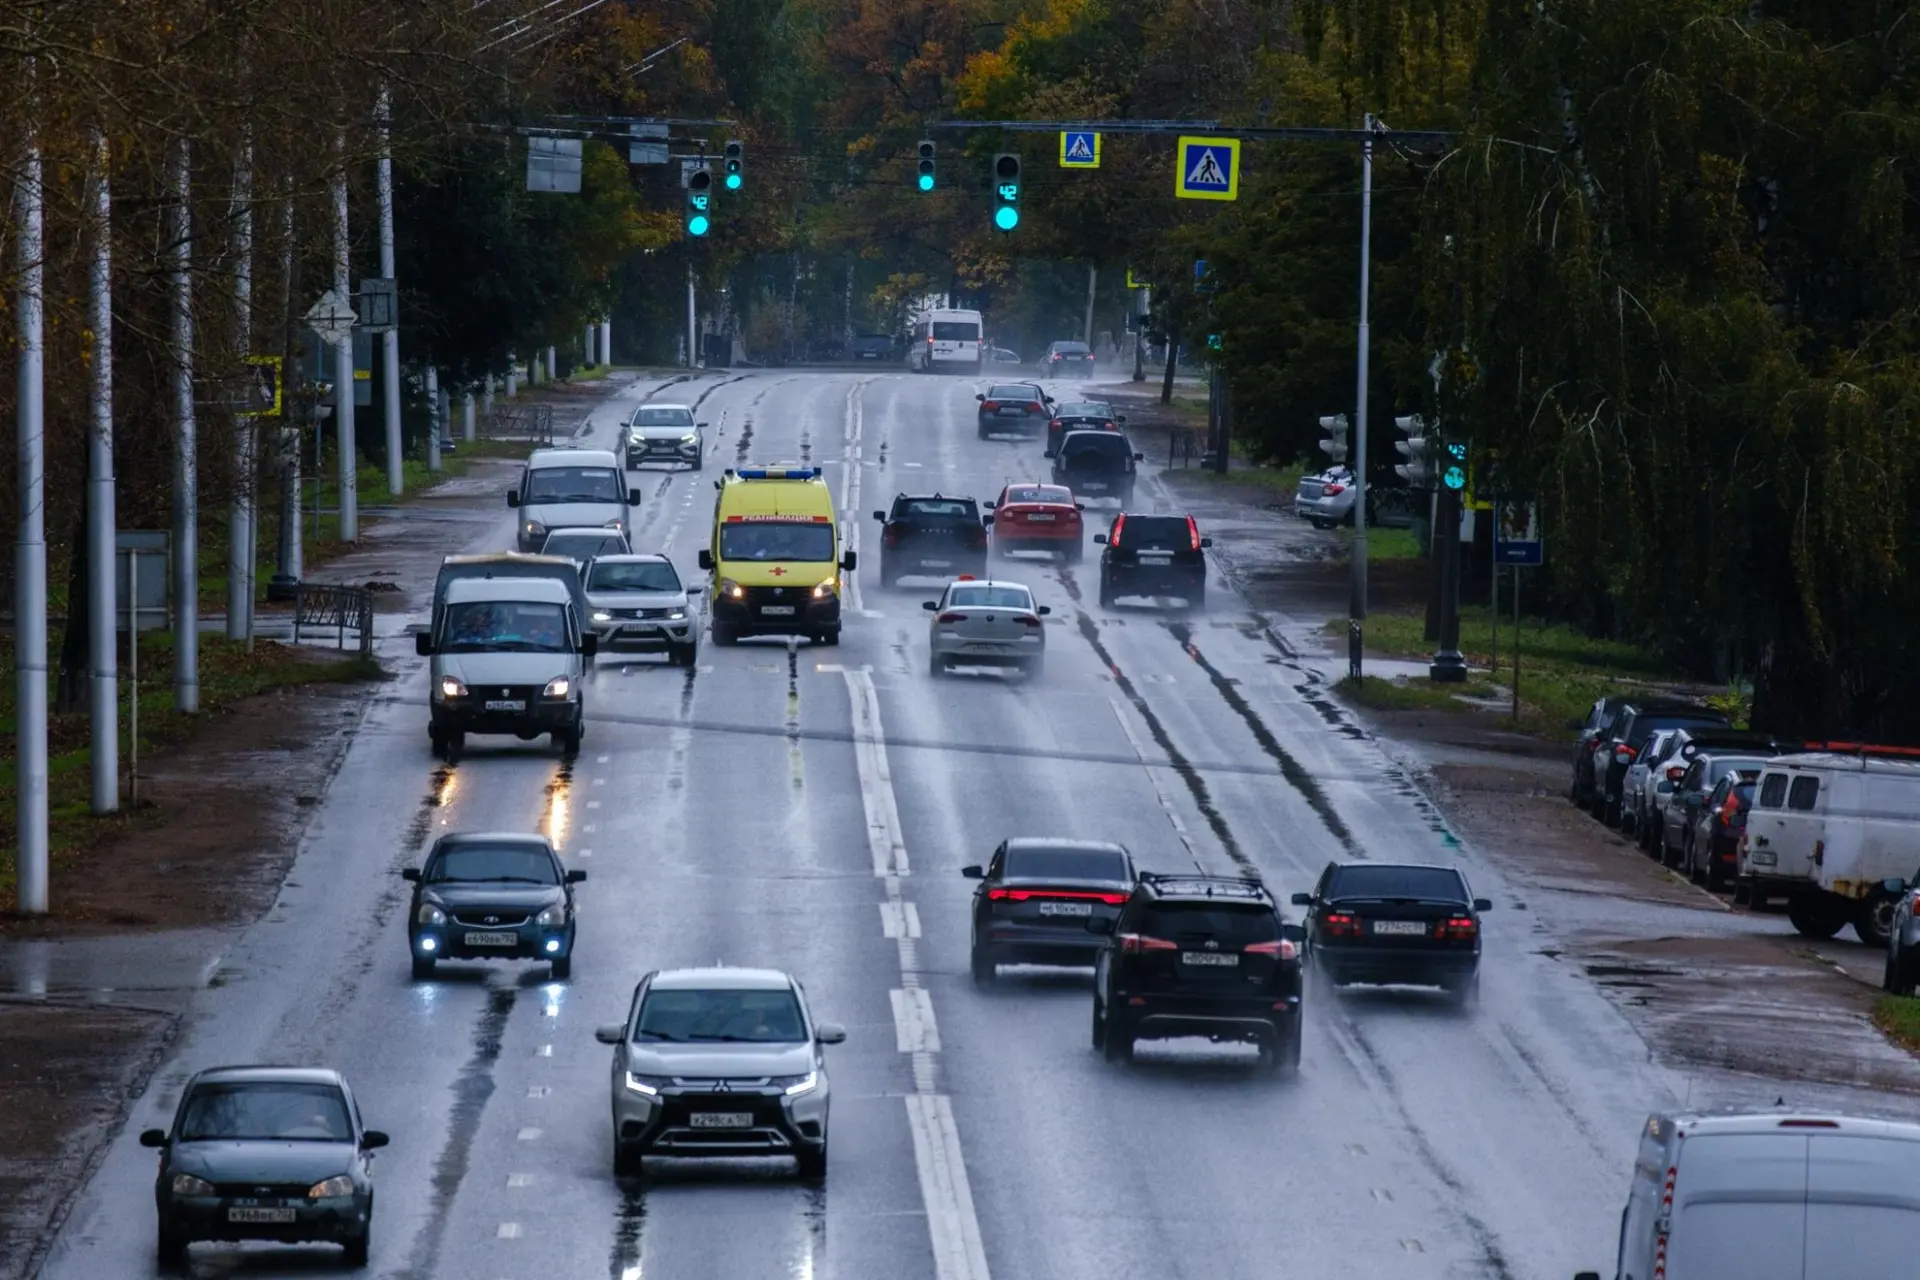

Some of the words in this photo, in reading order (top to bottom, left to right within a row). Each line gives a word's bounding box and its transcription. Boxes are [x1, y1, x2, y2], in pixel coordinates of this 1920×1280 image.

[999, 185, 1017, 200] 42
[692, 196, 707, 210] 42
[742, 514, 813, 522] РЕАНИМАЦИЯ
